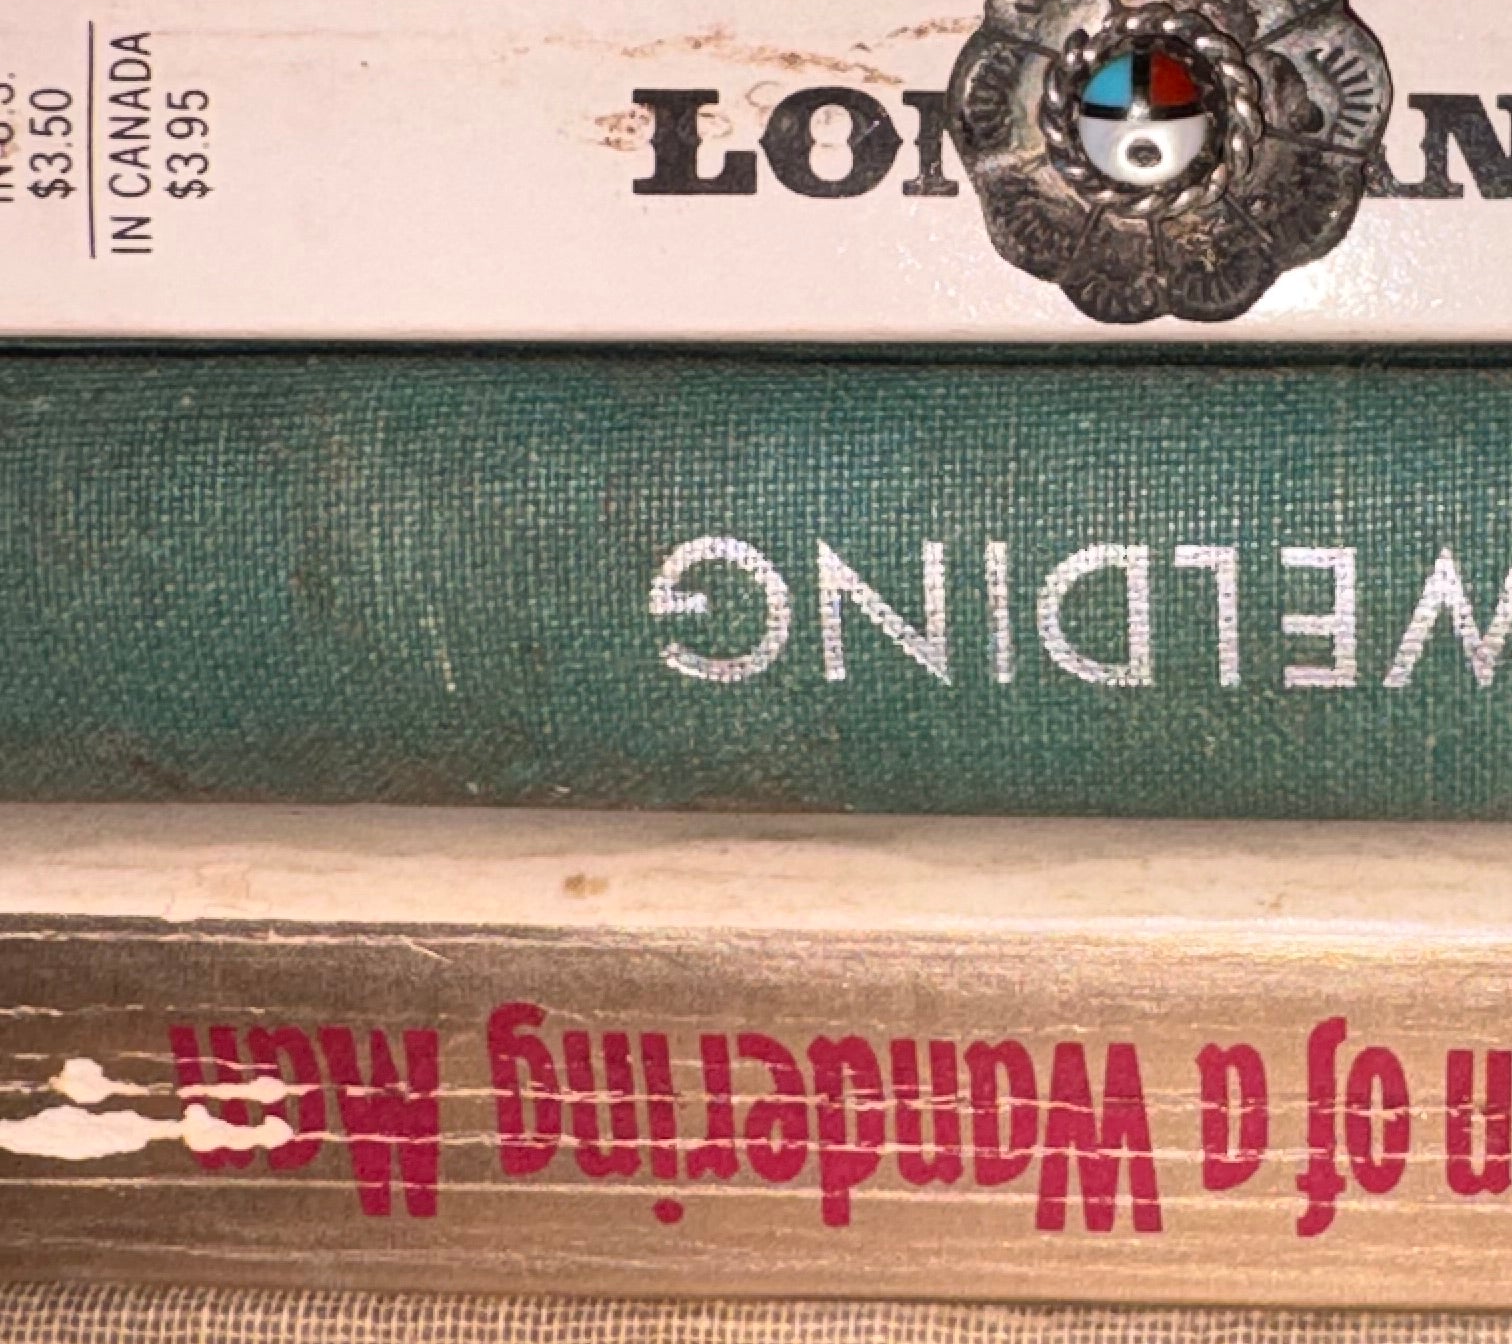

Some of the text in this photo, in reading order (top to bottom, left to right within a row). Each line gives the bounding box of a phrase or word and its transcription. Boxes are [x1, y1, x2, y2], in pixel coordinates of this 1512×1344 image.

[27, 88, 77, 199] $3.50
[107, 31, 154, 254] IN CANADA
[164, 88, 215, 199] $3.95
[168, 1024, 440, 1218] Man
[487, 1001, 1163, 1232] Wandering
[1195, 1042, 1269, 1191] a
[1294, 1016, 1412, 1237] of
